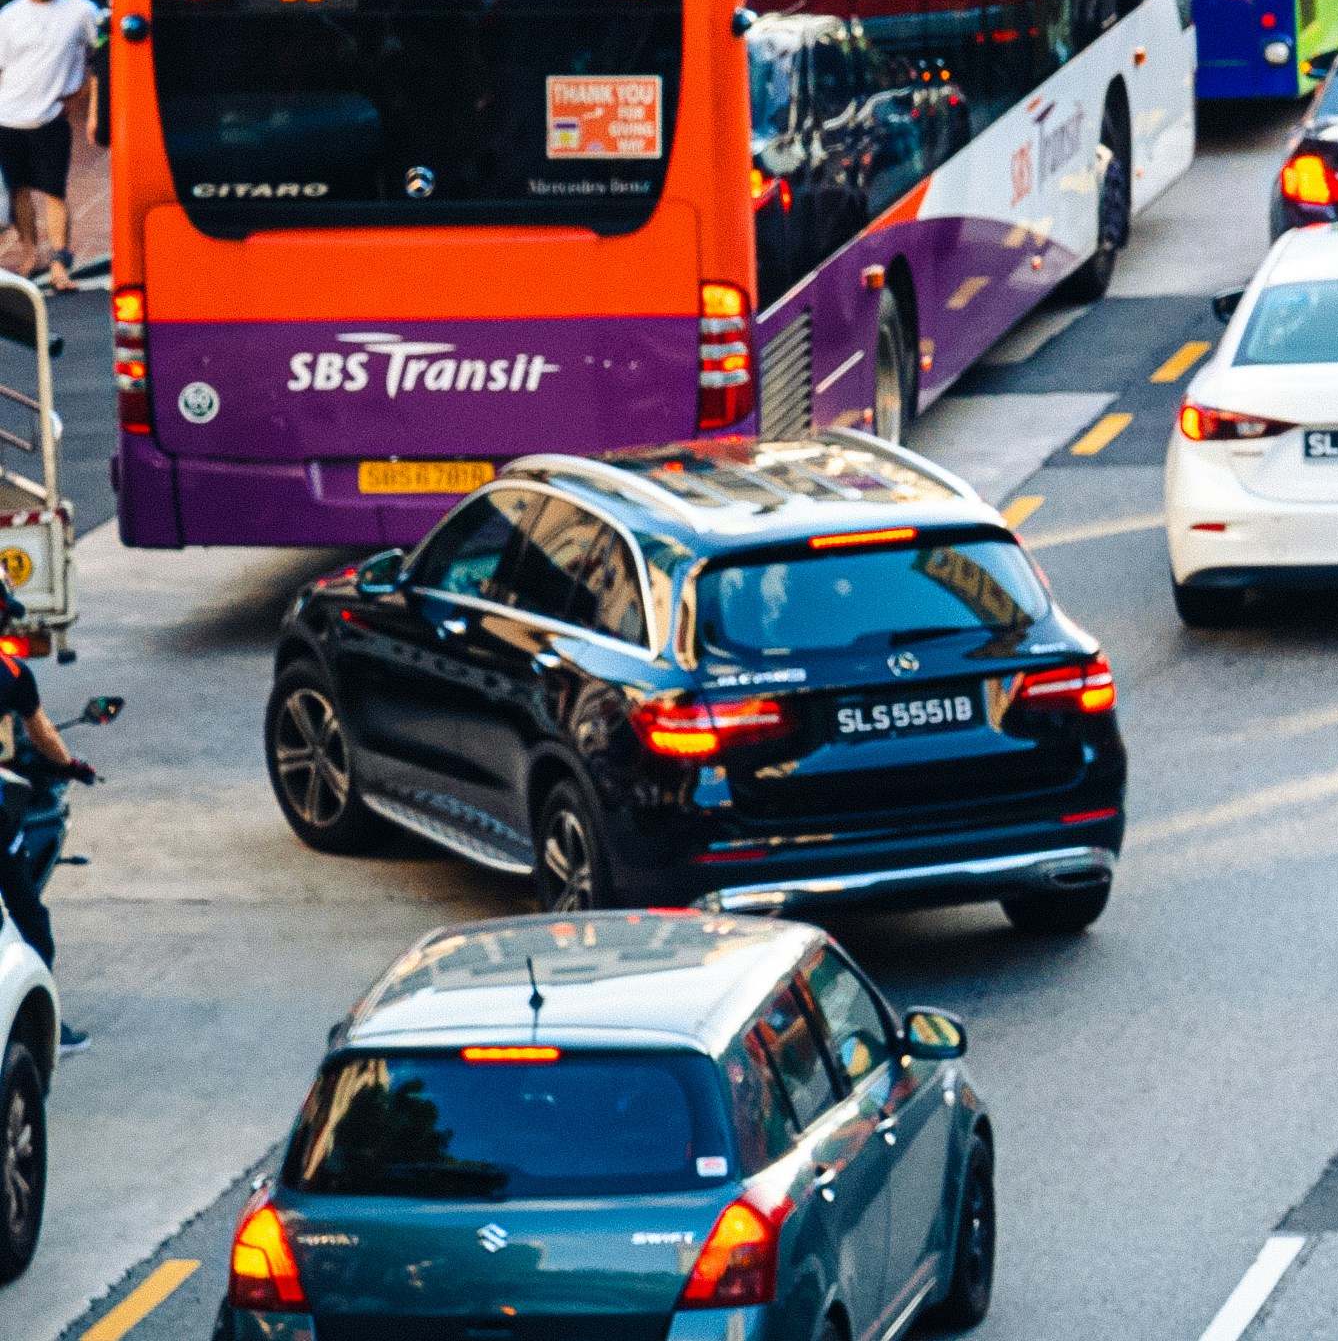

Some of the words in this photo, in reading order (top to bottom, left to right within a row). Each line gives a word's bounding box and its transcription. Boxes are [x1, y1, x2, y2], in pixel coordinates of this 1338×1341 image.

[553, 84, 613, 104] THANK
[616, 84, 655, 104] YOU
[618, 106, 645, 119] FOR
[193, 183, 329, 197] CITARO
[287, 351, 370, 392] SBS
[364, 341, 561, 400] Transit
[837, 696, 973, 733] SLS5551B
